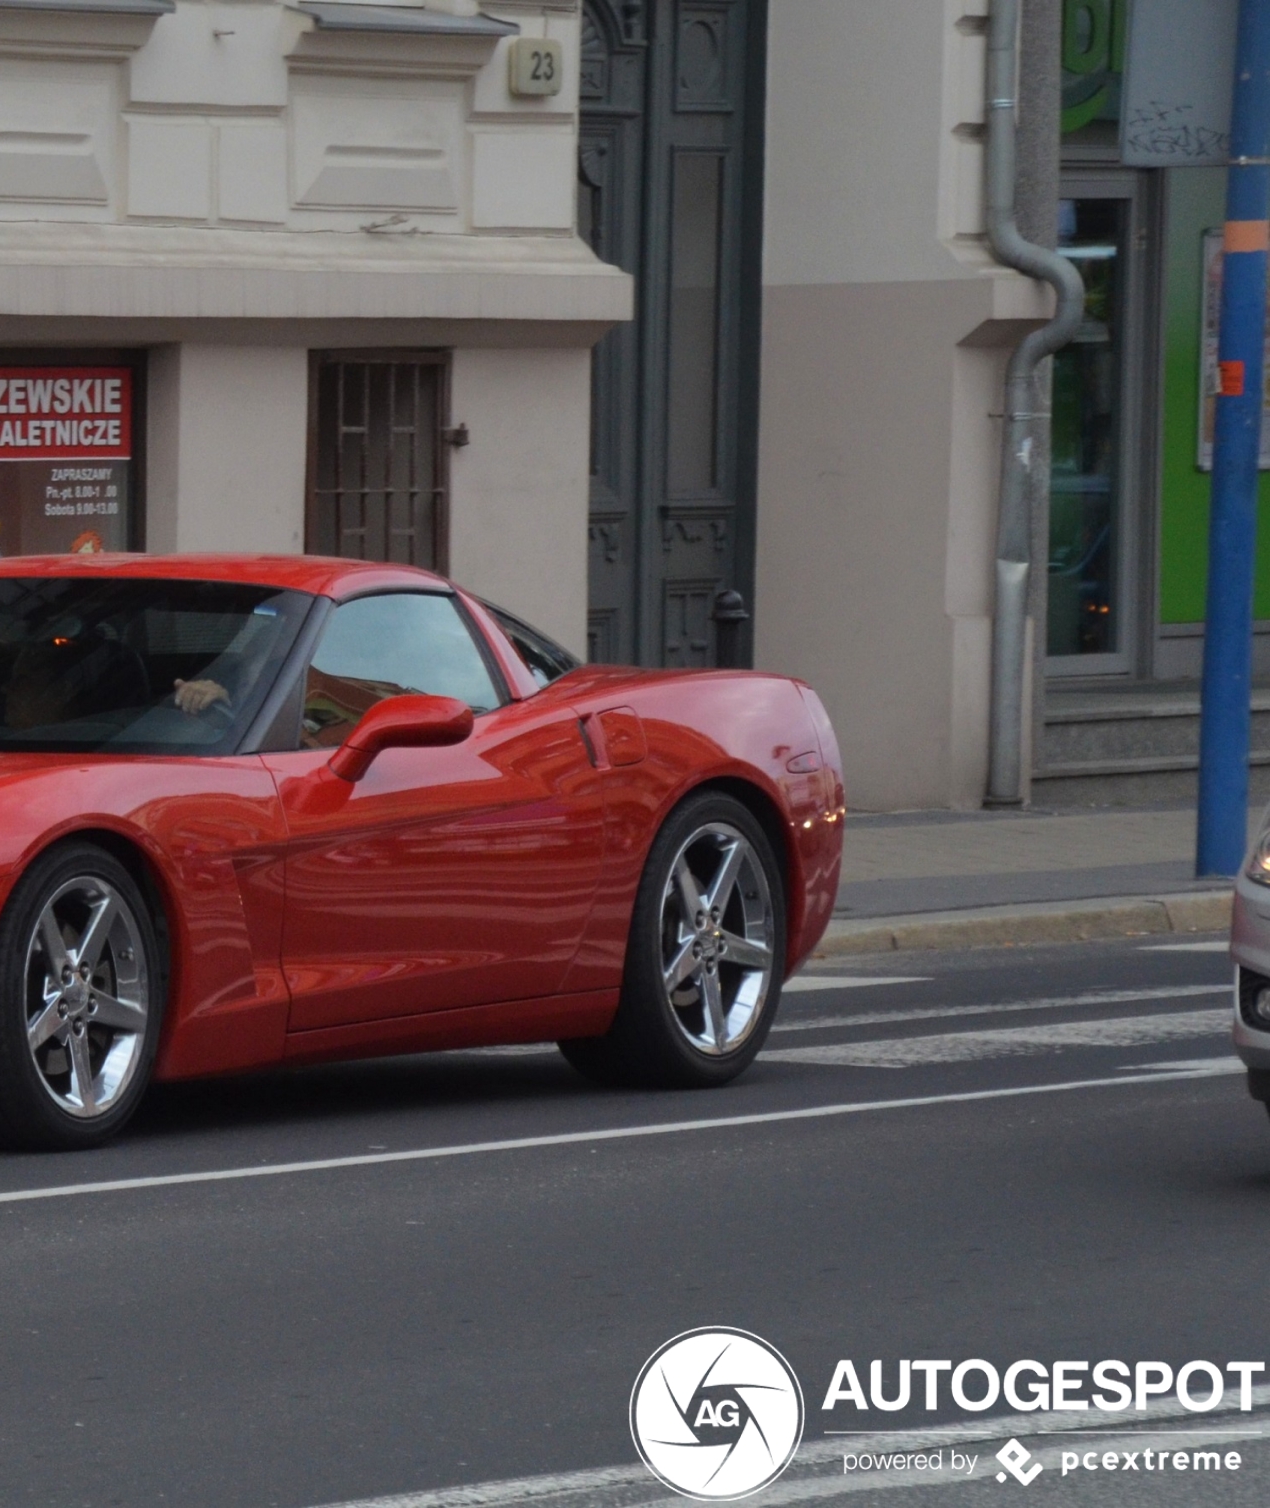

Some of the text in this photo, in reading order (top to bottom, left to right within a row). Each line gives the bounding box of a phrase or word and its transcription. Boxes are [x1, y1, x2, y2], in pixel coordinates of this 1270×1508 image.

[531, 50, 555, 82] 23
[51, 468, 113, 481] ZAPRASZAMY
[44, 503, 75, 516] Sobota
